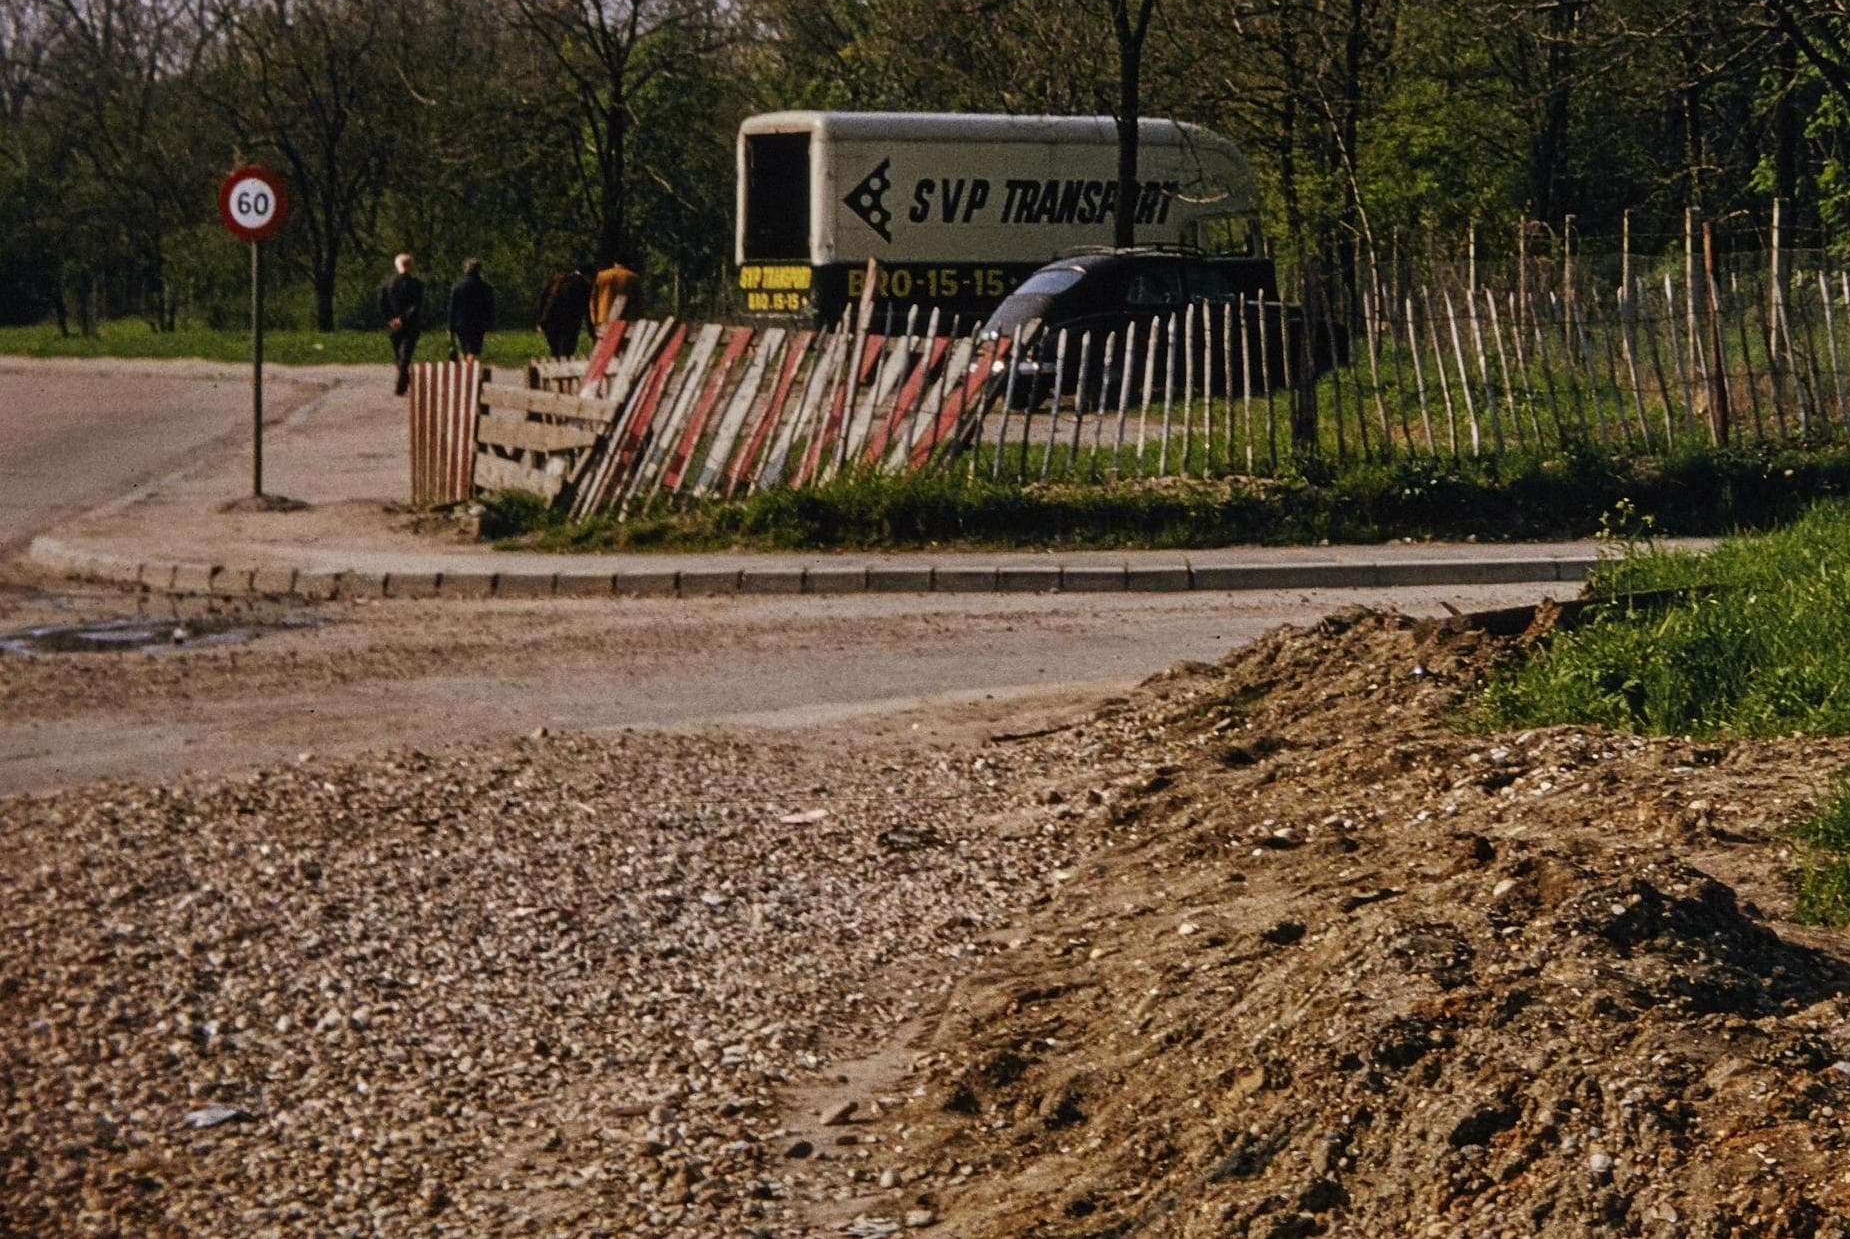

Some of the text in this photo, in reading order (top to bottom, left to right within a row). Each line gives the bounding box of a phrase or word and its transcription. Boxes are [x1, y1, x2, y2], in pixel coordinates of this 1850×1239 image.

[237, 191, 269, 216] 60
[909, 177, 1179, 225] SVP TRANSPRT
